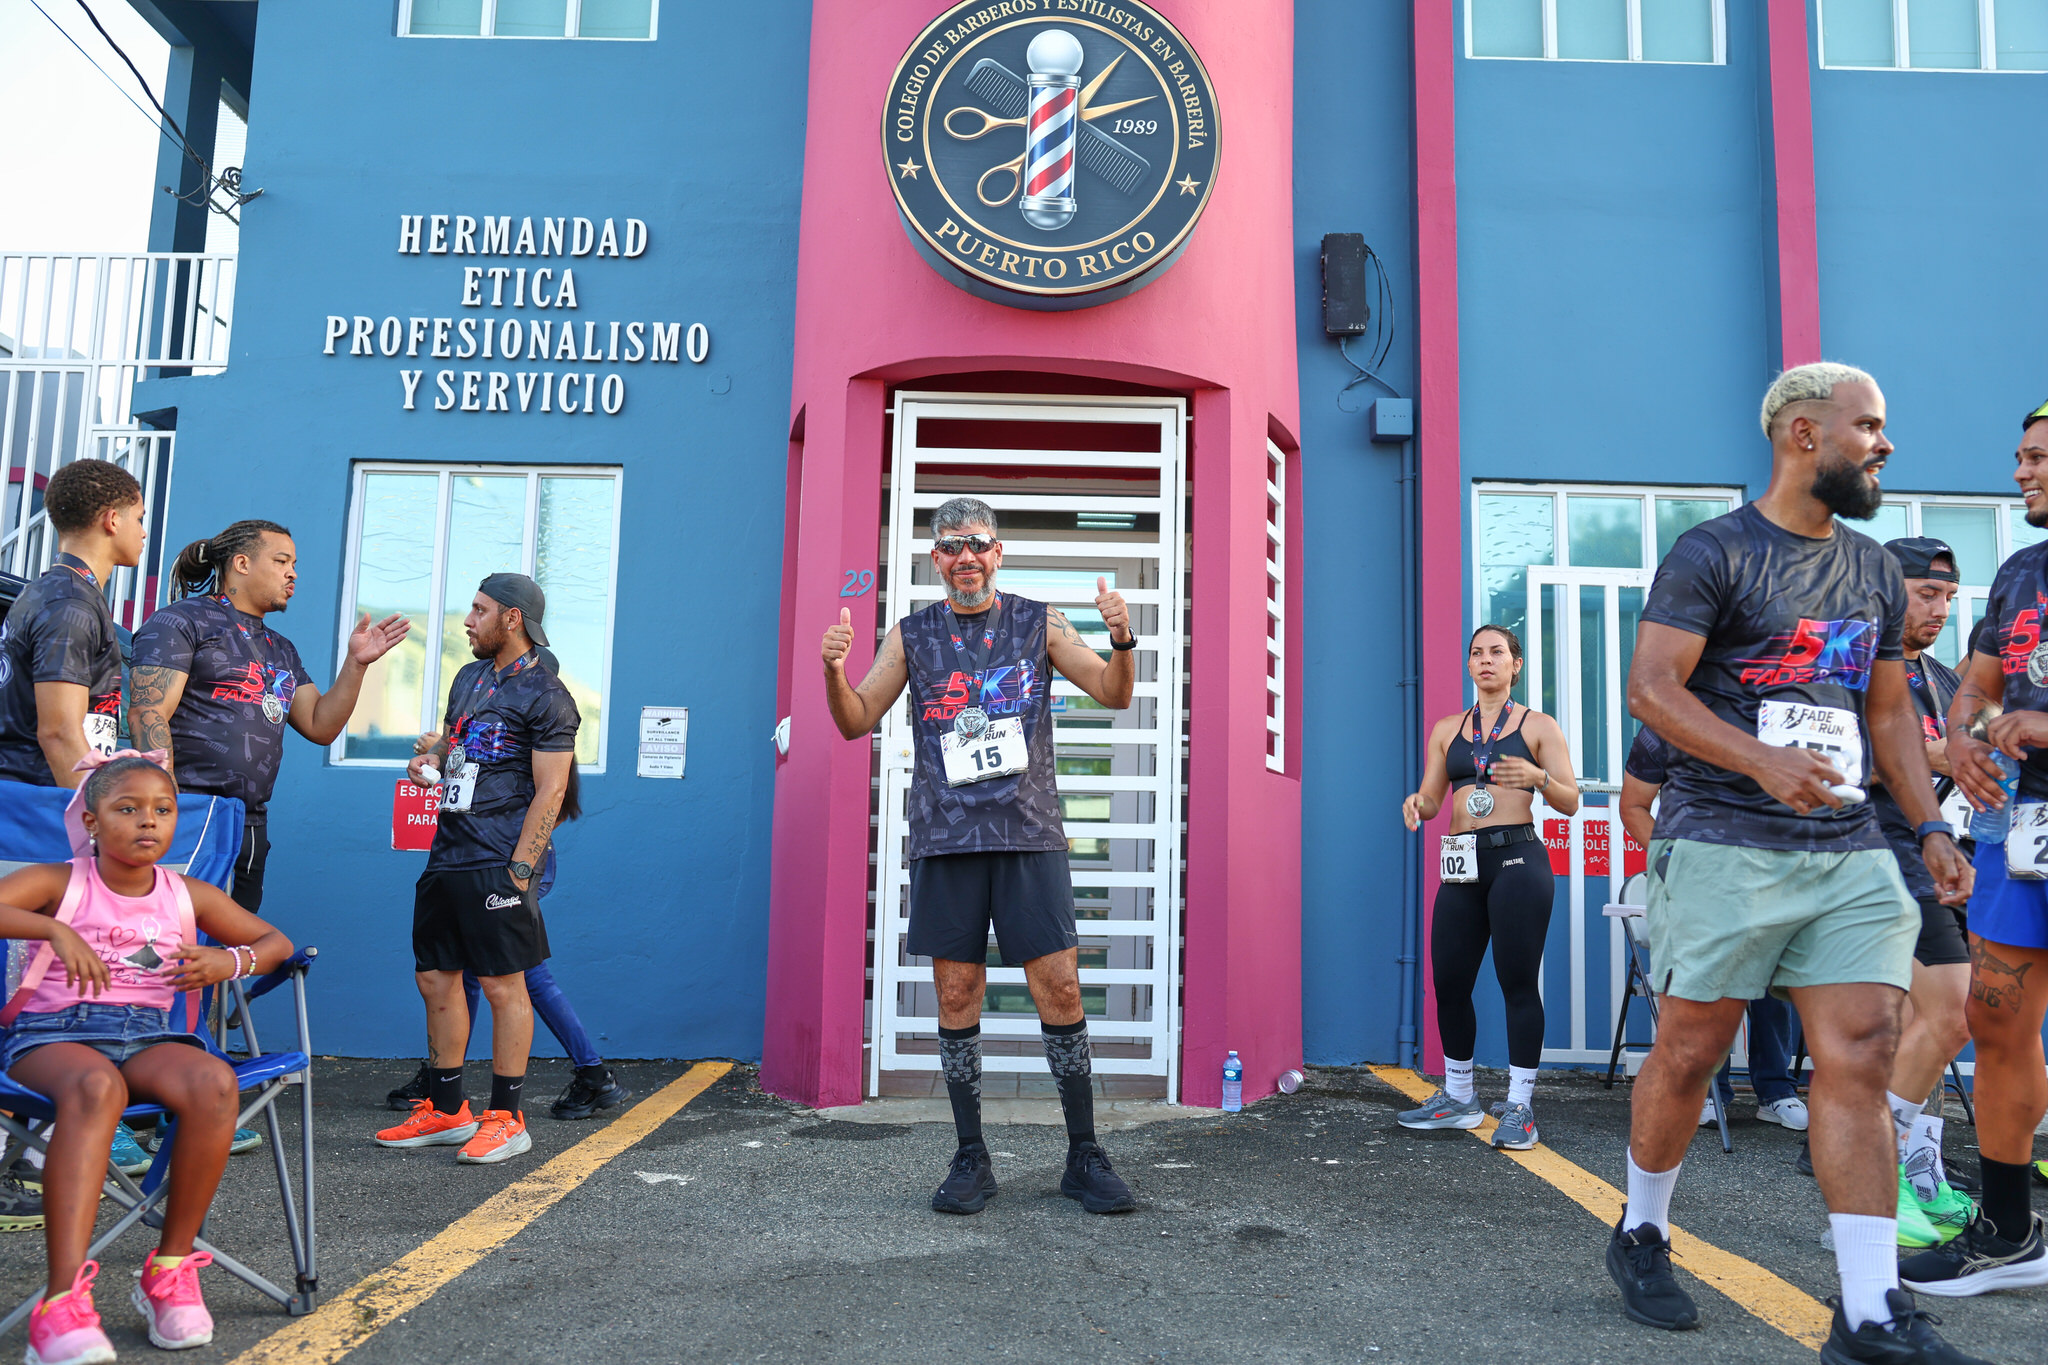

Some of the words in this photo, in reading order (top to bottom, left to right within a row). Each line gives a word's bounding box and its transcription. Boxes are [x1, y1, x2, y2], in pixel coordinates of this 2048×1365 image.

[897, 63, 932, 142] COLEGIO
[923, 39, 949, 65] DE
[944, 0, 1037, 46] BARBEROS
[1057, 0, 1154, 42] ESTILISTAS
[1150, 36, 1176, 62] EN
[1112, 118, 1158, 135] 1989
[398, 214, 648, 257] HERMANDAD
[934, 217, 1067, 280] PUERTO
[1077, 231, 1156, 277] RICO
[461, 267, 577, 308] ETICA
[323, 315, 709, 363] PROFESIONALISMO
[400, 370, 423, 410] Y
[434, 370, 625, 414] SERVICIO
[840, 569, 875, 598] 29
[1780, 618, 1872, 669] 5K
[1740, 667, 1815, 686] FADE
[211, 687, 264, 705] FADE
[1801, 708, 1835, 723] FADE
[984, 730, 1006, 742] RUN
[1818, 723, 1844, 736] RUN
[645, 744, 679, 752] AVISO
[971, 746, 1002, 771] 15
[407, 813, 438, 826] PARA
[1442, 856, 1467, 875] 102
[94, 945, 119, 963] to
